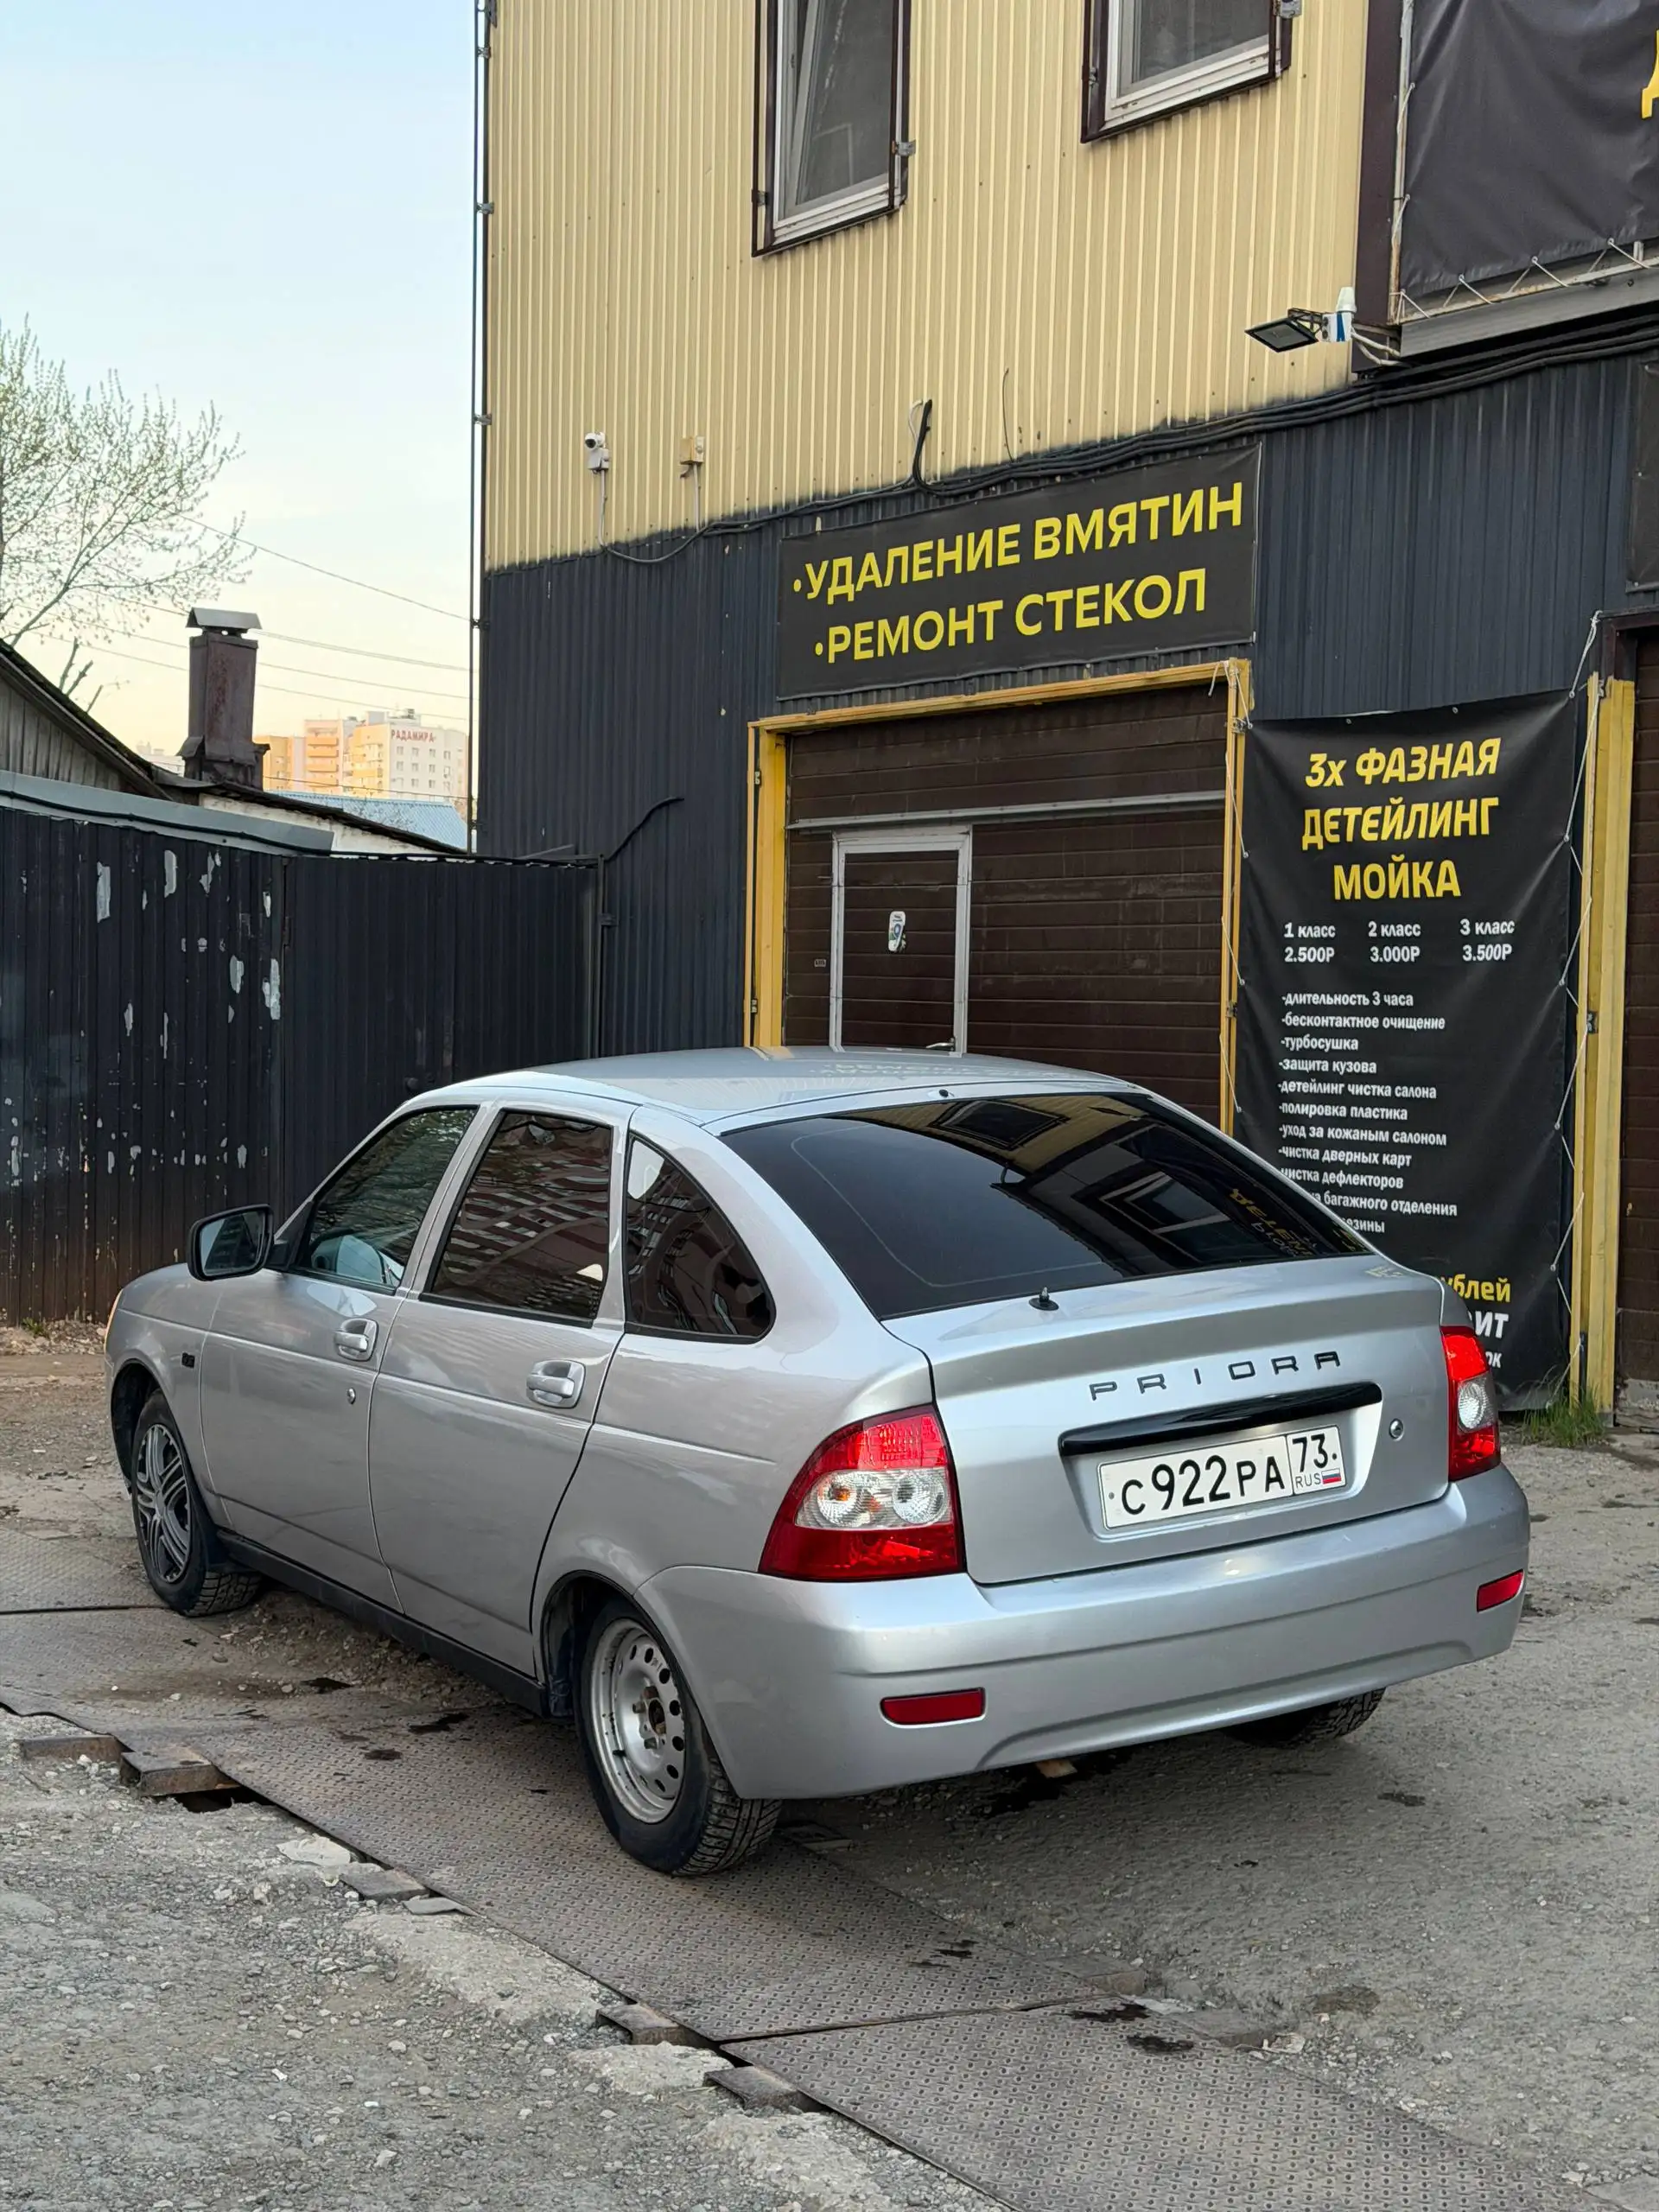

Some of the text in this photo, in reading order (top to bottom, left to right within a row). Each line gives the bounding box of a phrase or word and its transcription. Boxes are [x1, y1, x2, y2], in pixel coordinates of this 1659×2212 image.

[1033, 482, 1243, 560] ВМЯТИН
[1015, 569, 1206, 636] СТЕКОЛ
[1356, 737, 1502, 785] ФАЗНАЯ
[1301, 797, 1499, 850] ДЕТЕЙЛИНГ
[1333, 854, 1461, 900] МОЙКА
[1284, 923, 1336, 938] 1 класс
[1368, 922, 1421, 937] 2 класс
[1460, 918, 1515, 936] 3 класс
[1372, 991, 1381, 1006] 3
[1383, 994, 1414, 1006] часа
[1382, 1015, 1446, 1031] очищение
[1332, 1061, 1376, 1075] кузова
[1348, 1084, 1391, 1097] чистка
[1395, 1085, 1436, 1099] салона
[1350, 1106, 1408, 1120] пластика
[1309, 1126, 1324, 1138] за
[1327, 1128, 1389, 1142] кожаным
[1392, 1131, 1446, 1146] салоном
[1322, 1150, 1379, 1165] дверных
[1382, 1153, 1412, 1168] карт
[1322, 1170, 1404, 1191] дефлекторов
[1324, 1190, 1388, 1211] багажного
[1390, 1199, 1458, 1217] отделения
[1089, 1351, 1341, 1402] PRIORA
[1292, 1433, 1330, 1473] 73
[1296, 1472, 1322, 1490] RUS
